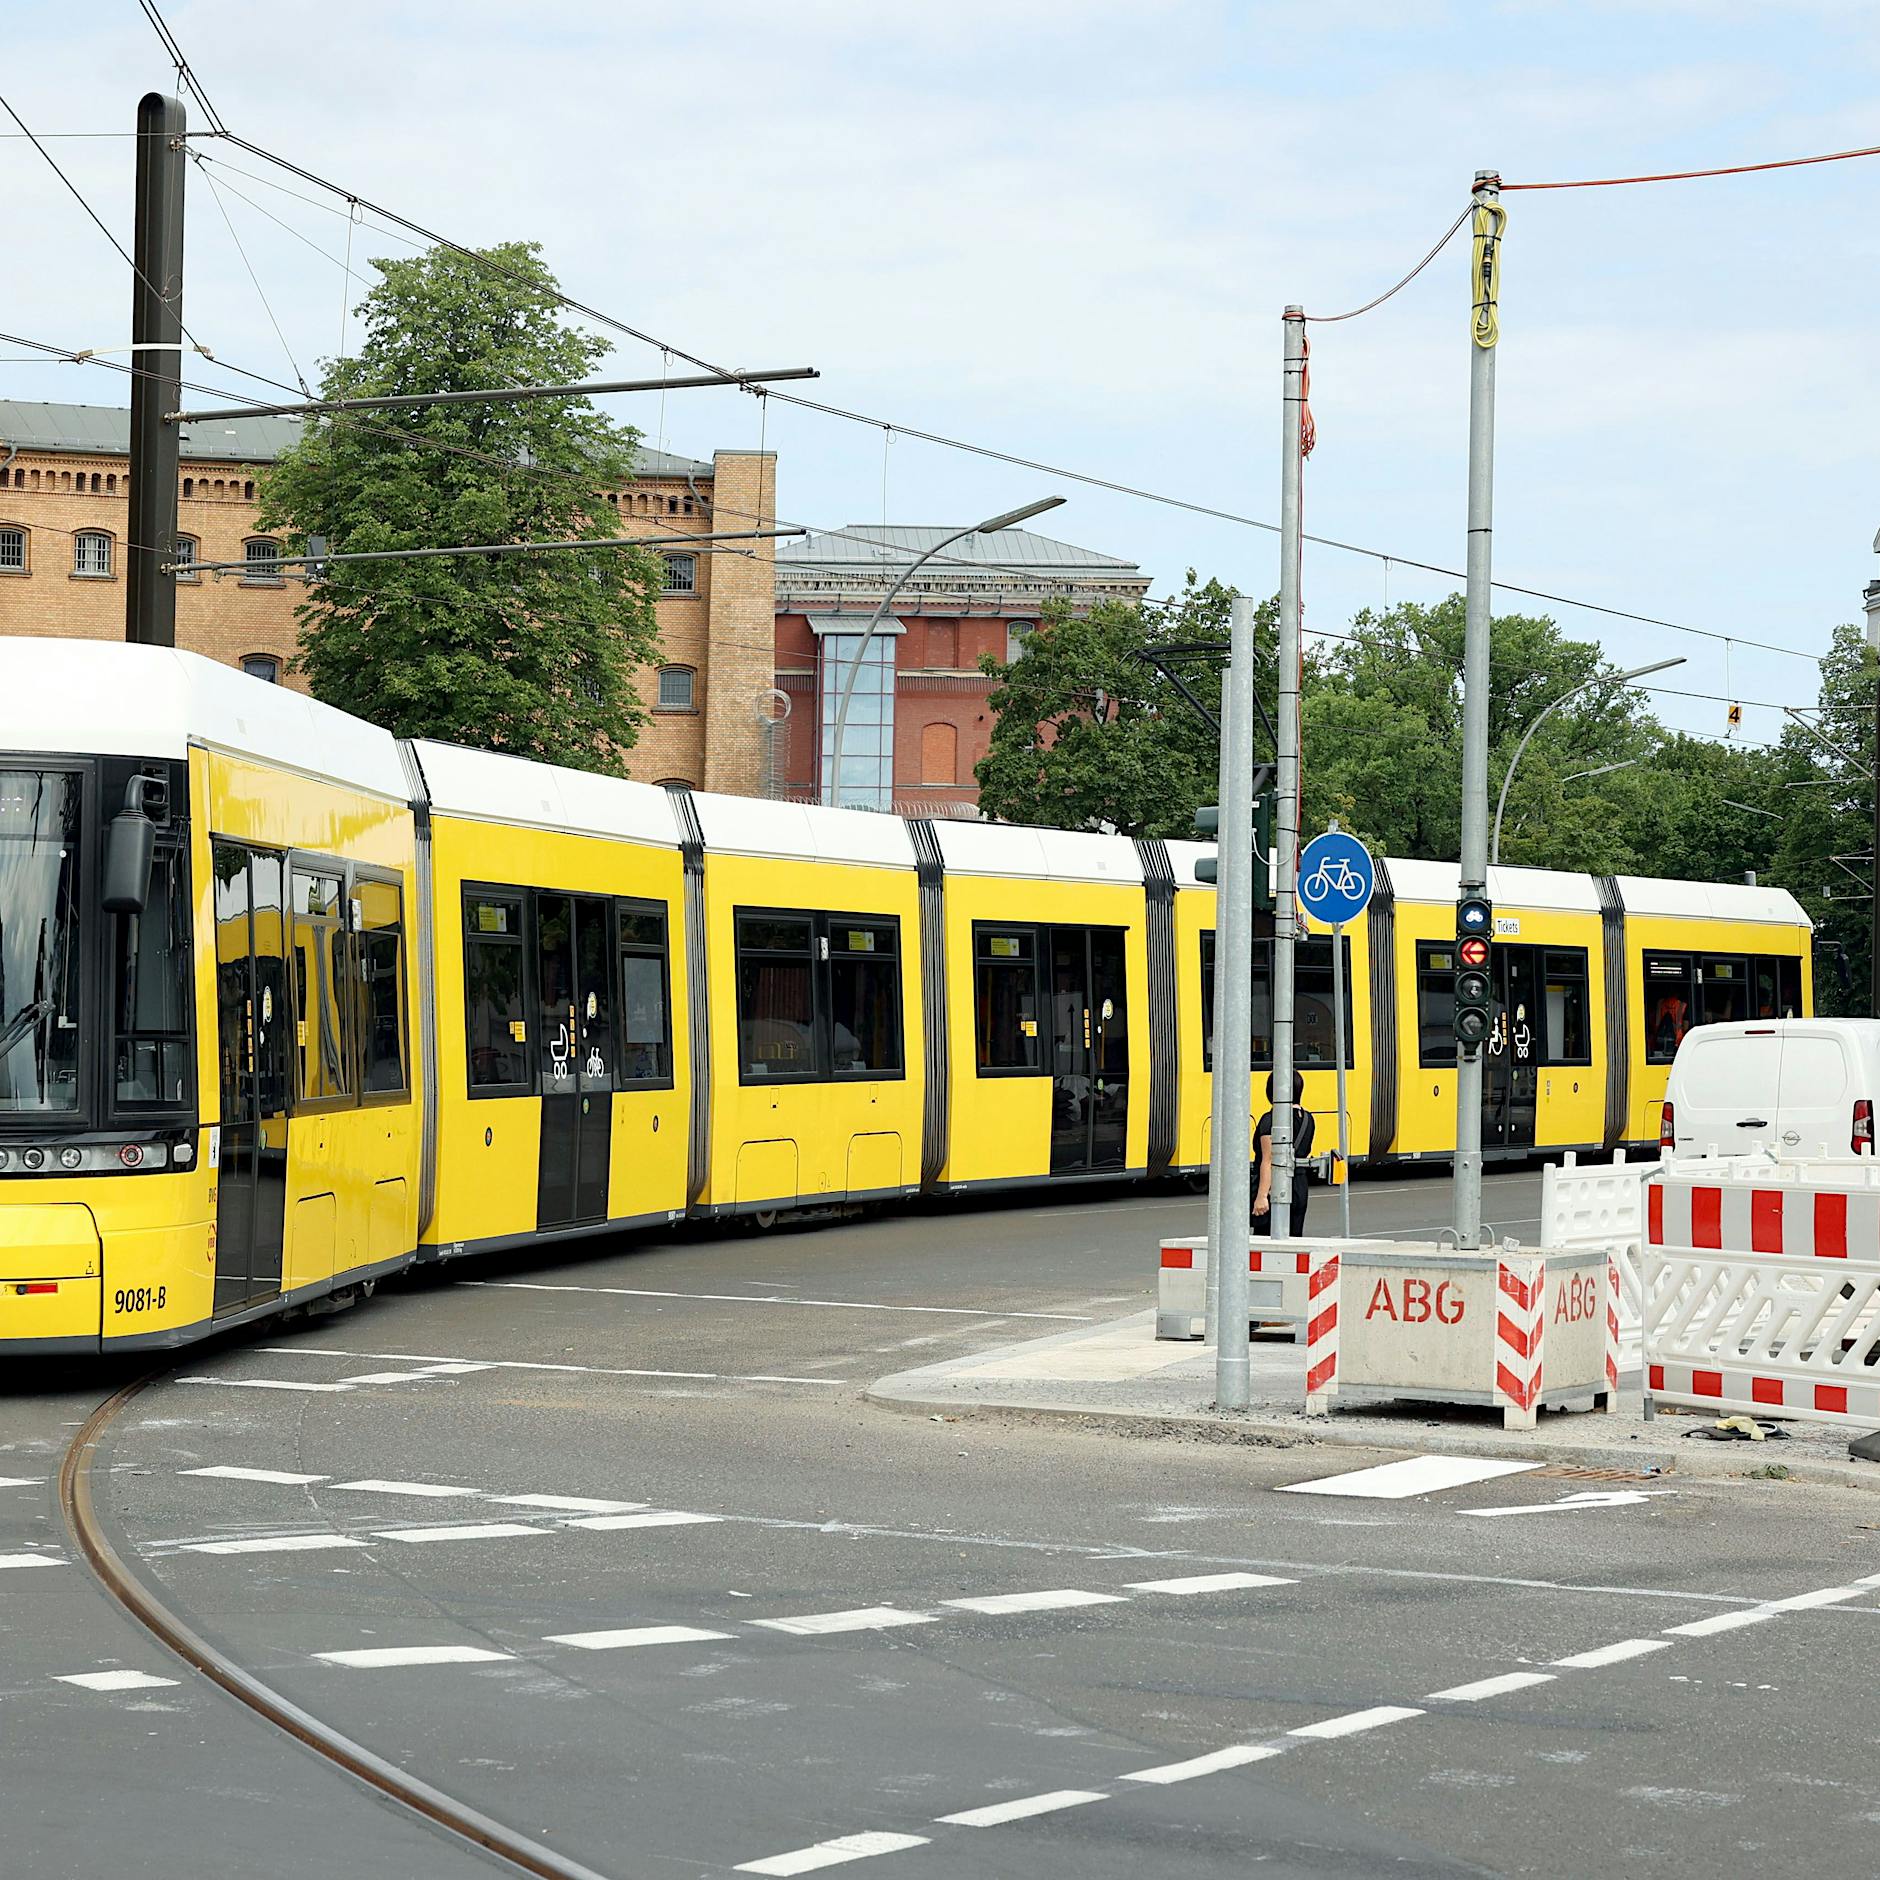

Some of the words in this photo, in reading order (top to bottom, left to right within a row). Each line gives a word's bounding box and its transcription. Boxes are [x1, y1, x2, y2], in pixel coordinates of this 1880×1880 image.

[1729, 706, 1740, 723] 4
[1497, 920, 1518, 933] Tickets
[115, 1286, 166, 1314] 9081-B
[1365, 1278, 1465, 1324] ABG
[1554, 1277, 1596, 1325] ABG
